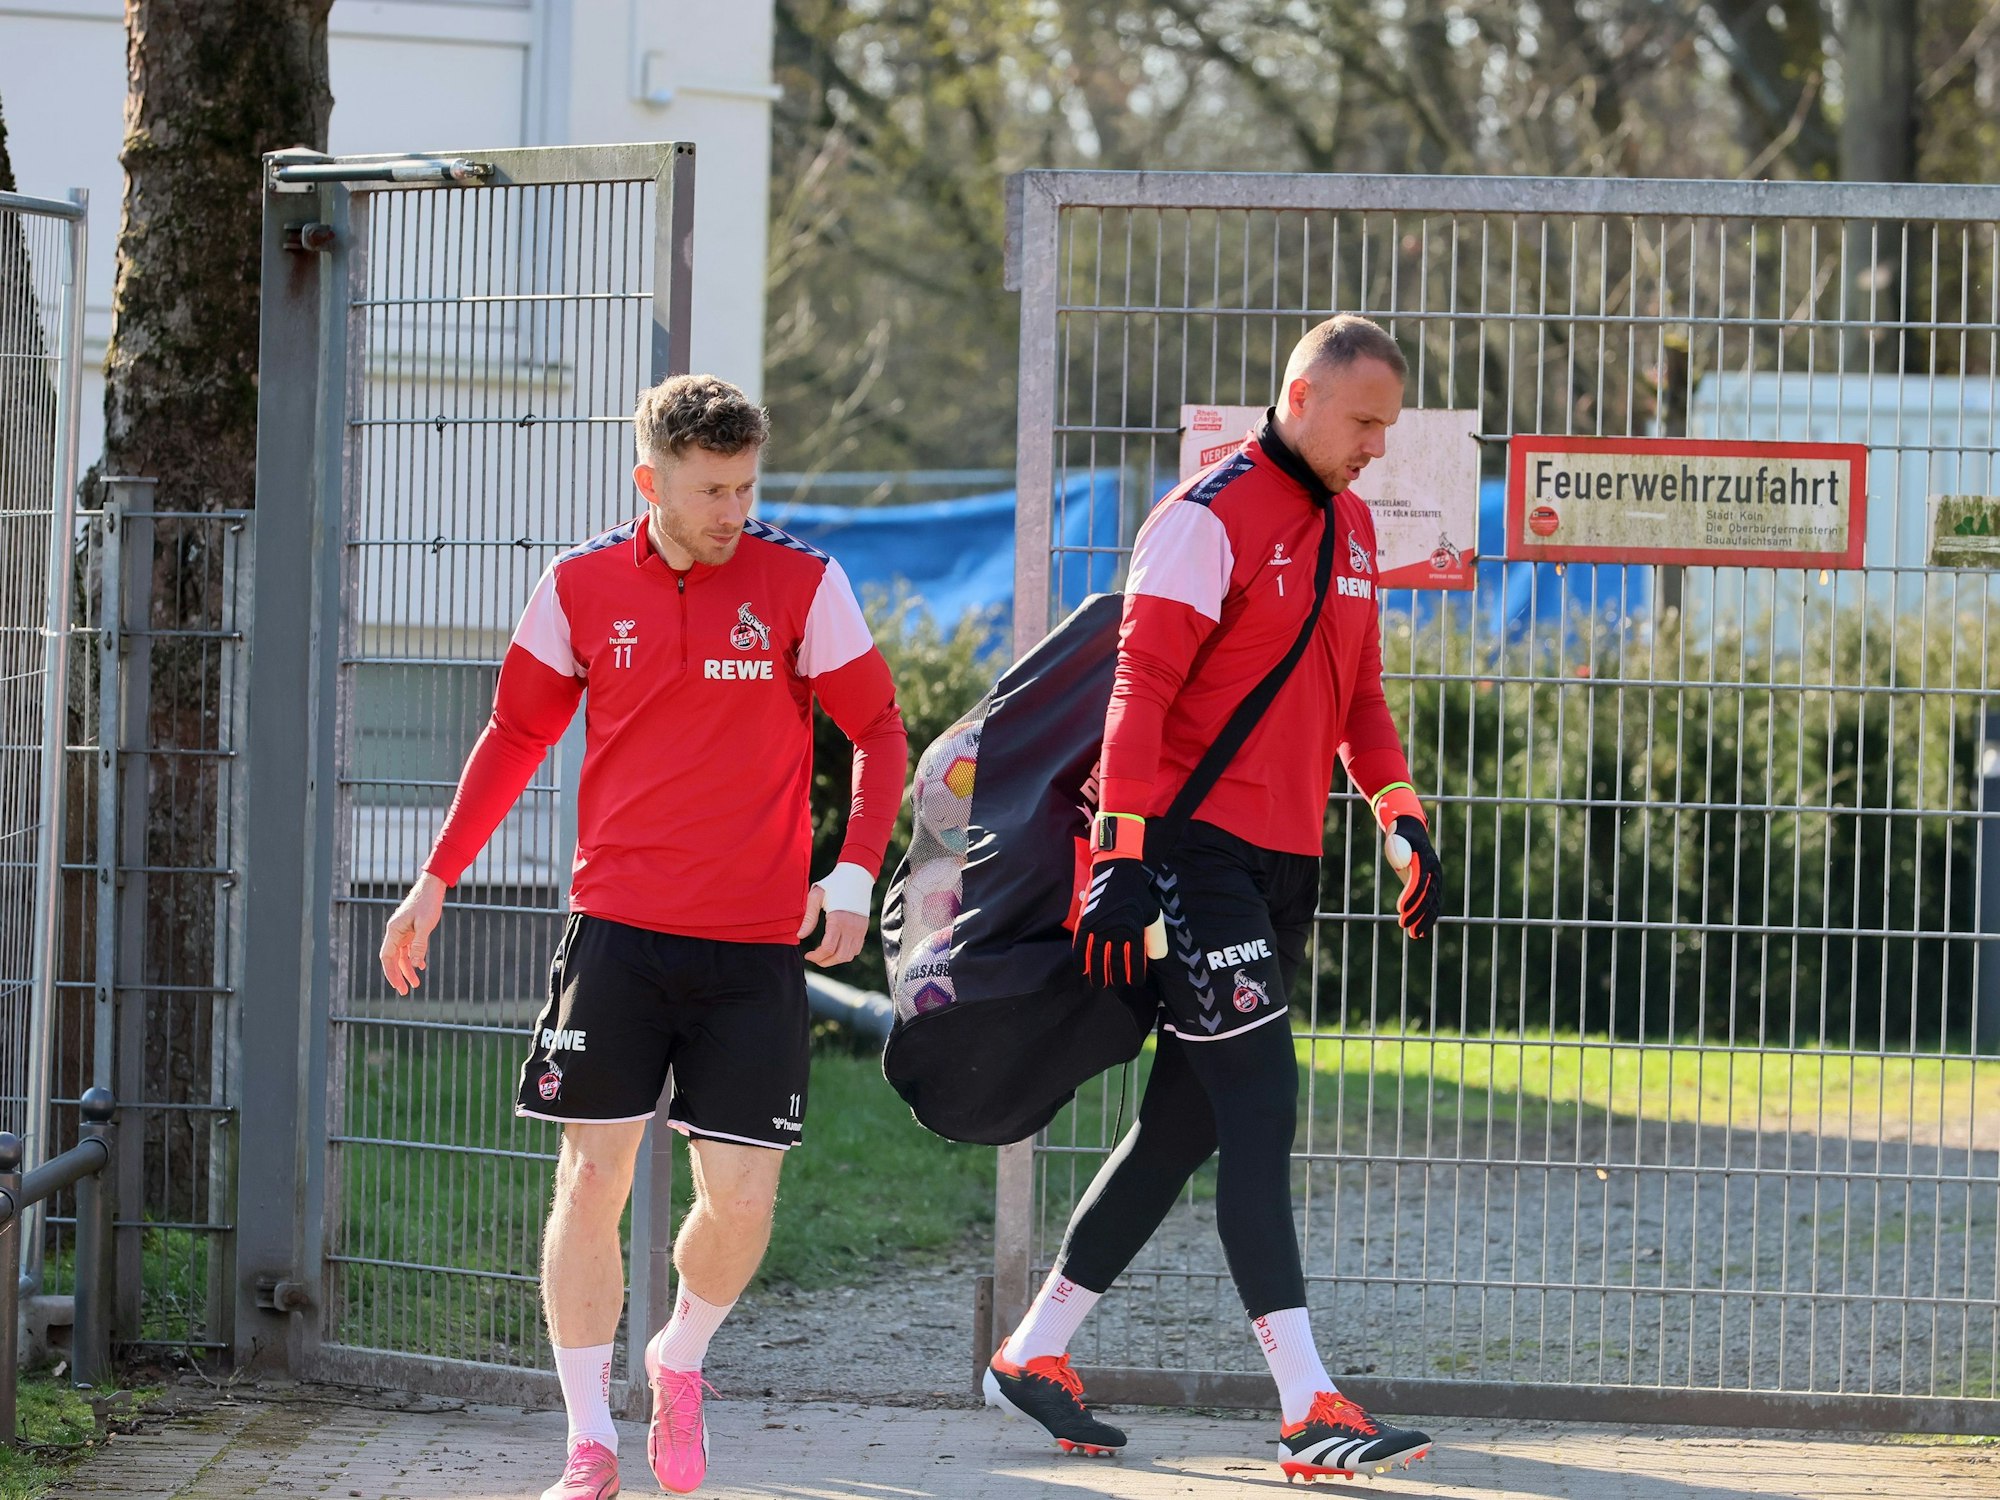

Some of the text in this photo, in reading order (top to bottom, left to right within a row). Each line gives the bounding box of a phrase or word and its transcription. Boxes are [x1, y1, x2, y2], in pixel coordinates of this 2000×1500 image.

[1536, 460, 1839, 506] Feuerwehrzufahrt
[1706, 510, 1733, 520] Stadt
[1706, 522, 1722, 532] Die
[1705, 535, 1792, 546] Bauaufsichtsamt
[1276, 574, 1284, 597] 1
[609, 636, 638, 645] hummel
[613, 645, 632, 669] 11
[704, 659, 774, 680] REWE
[1206, 938, 1273, 971] REWE
[541, 1027, 587, 1052] RWE
[790, 1093, 800, 1118] 11
[1056, 1282, 1073, 1297] FC
[1260, 1329, 1275, 1345] FC
